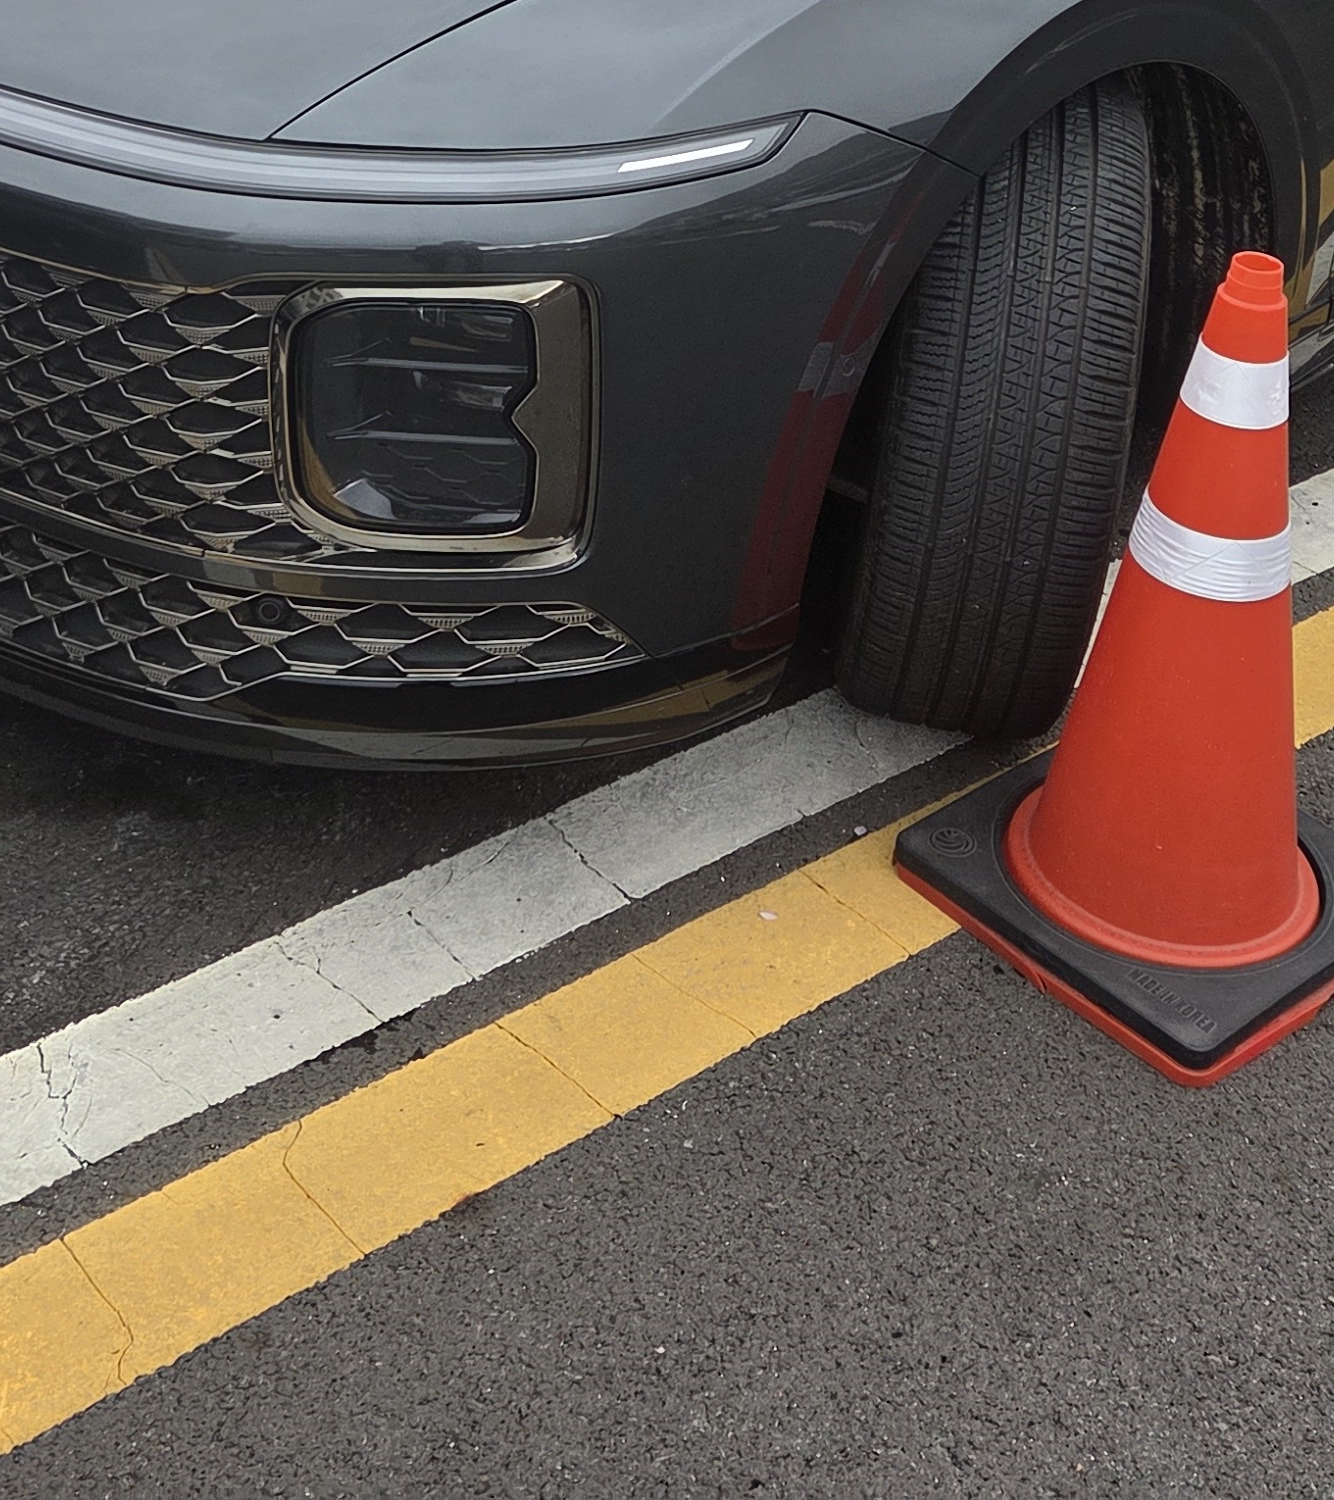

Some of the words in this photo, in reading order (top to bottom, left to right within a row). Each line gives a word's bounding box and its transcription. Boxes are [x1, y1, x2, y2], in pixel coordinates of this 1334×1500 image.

[1128, 968, 1165, 996] MADE
[1159, 988, 1181, 1006] IN
[1174, 1000, 1218, 1034] KOREA
